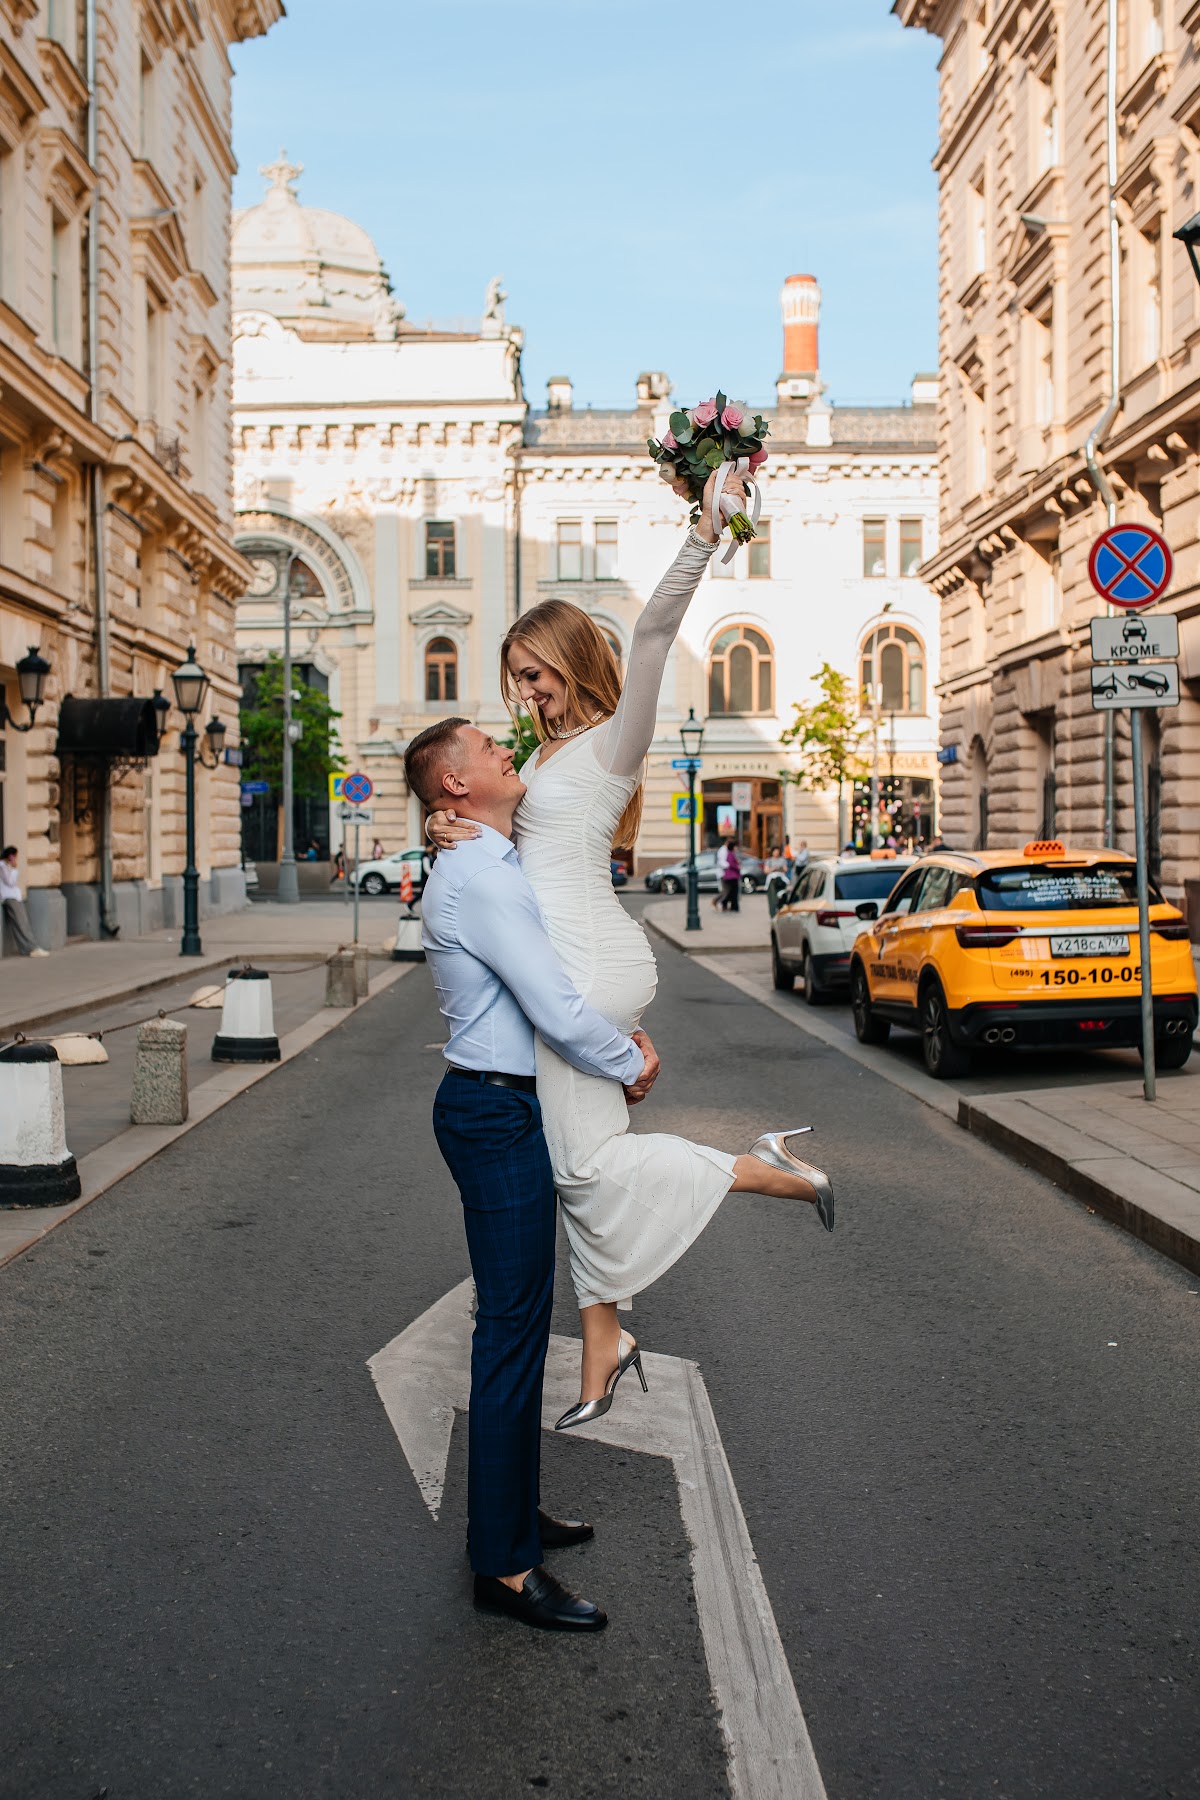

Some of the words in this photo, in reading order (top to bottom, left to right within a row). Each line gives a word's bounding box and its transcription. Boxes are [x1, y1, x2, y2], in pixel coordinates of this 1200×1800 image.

[1110, 643, 1160, 657] КРОМЕ
[1106, 935, 1125, 946] 797
[1010, 969, 1034, 978] (495)
[1040, 966, 1142, 985] 150-10-05
